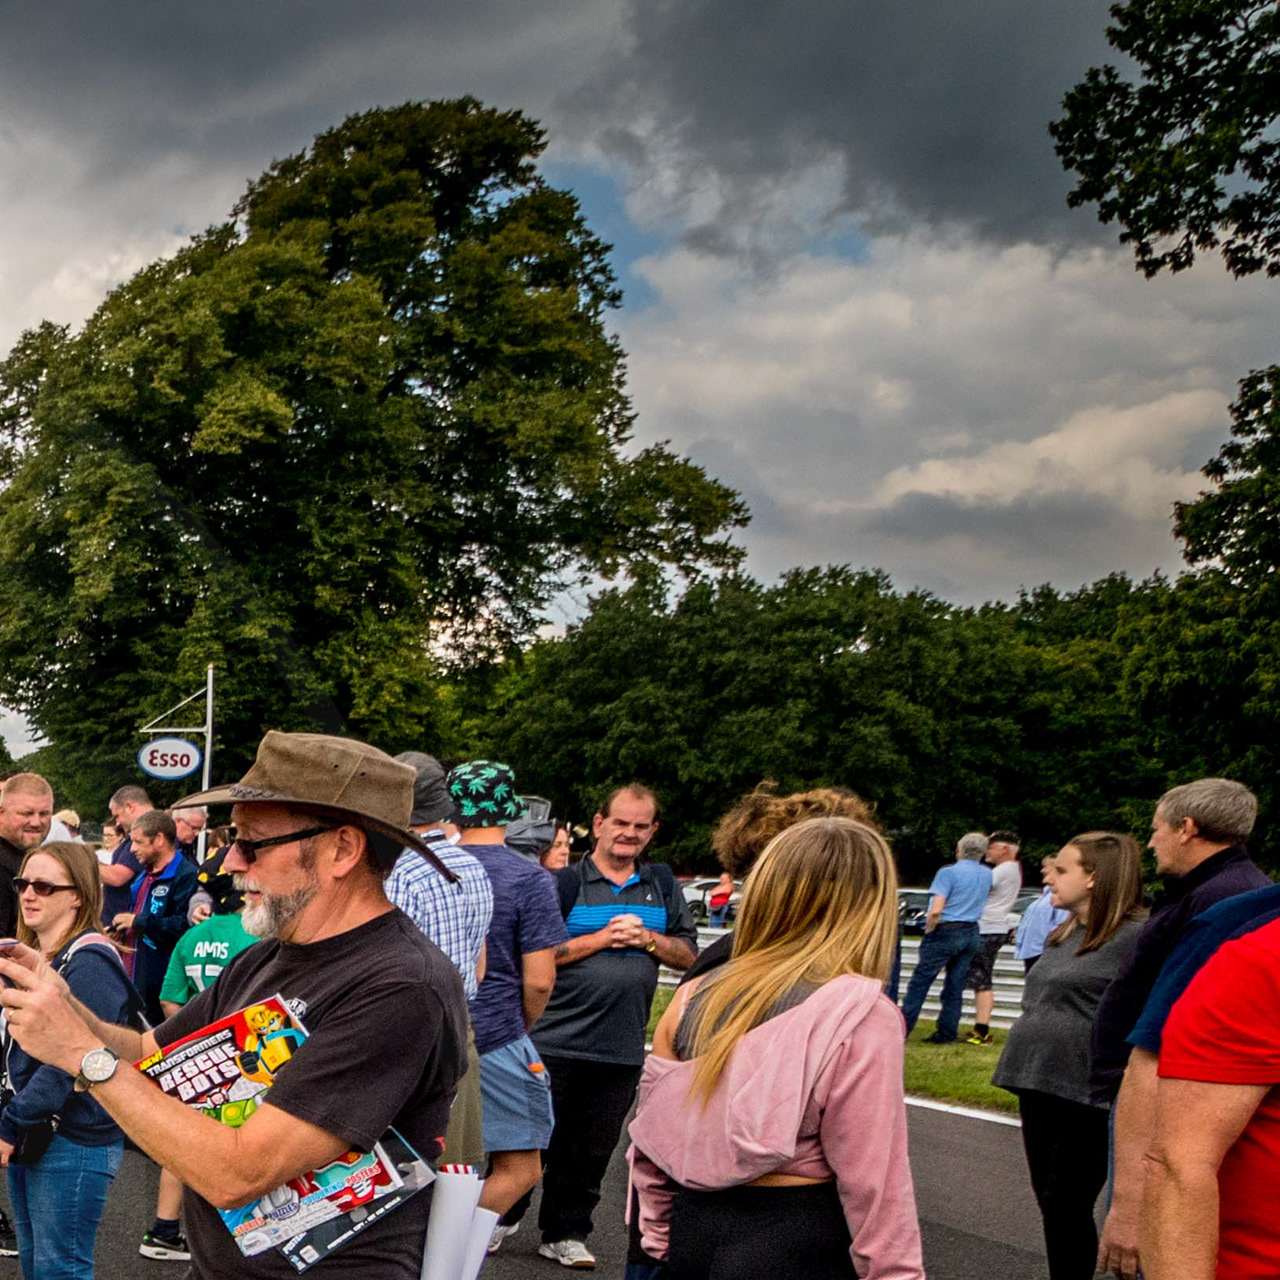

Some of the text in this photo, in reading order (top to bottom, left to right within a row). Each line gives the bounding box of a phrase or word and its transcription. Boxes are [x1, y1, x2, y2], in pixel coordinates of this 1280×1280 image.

[148, 749, 191, 767] Esso
[146, 1029, 233, 1077] TRANSFORMERS
[158, 1043, 240, 1092] RESCUE
[177, 1060, 240, 1101] BOTS
[346, 1164, 381, 1186] POSTERS
[268, 1203, 298, 1219] PUZZLES
[235, 1217, 265, 1234] STORIES
